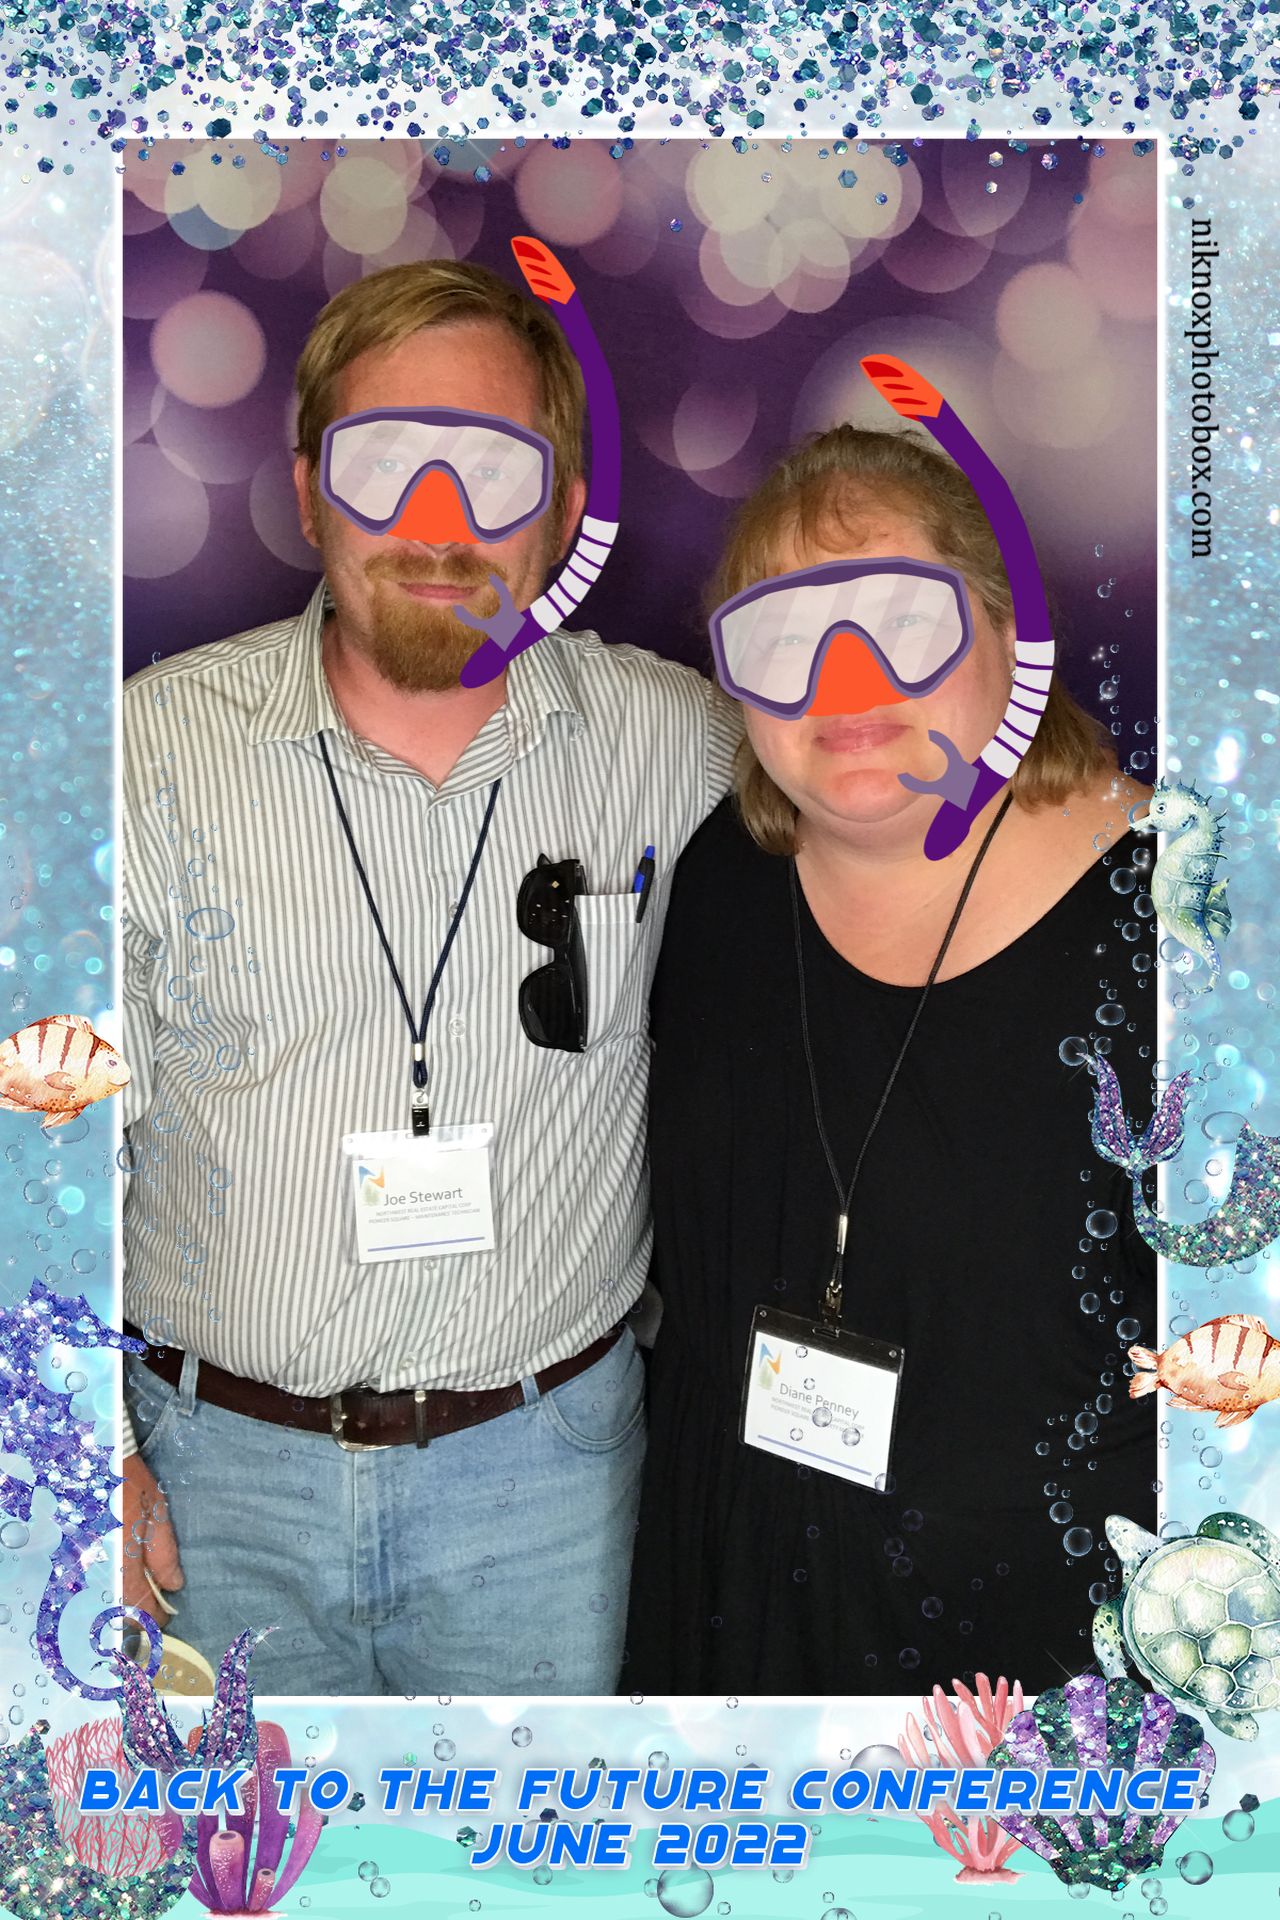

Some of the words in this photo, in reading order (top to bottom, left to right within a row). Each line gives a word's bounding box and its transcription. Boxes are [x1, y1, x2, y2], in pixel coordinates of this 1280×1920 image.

[383, 1193, 407, 1207] Joe
[409, 1187, 464, 1204] Stewart
[375, 1208, 407, 1217] NORTHWEST
[438, 1203, 458, 1211] CAPITAL
[390, 1215, 410, 1223] SQUARE
[415, 1211, 450, 1220] MAINTENANCE
[450, 1208, 481, 1216] TECHNICIAN
[779, 1382, 813, 1404] Diane
[815, 1394, 860, 1421] Penney
[770, 1403, 791, 1415] PIONEER
[791, 1410, 810, 1422] SQUARE
[771, 1396, 801, 1410] NORTHWEST
[801, 1406, 813, 1415] REAL
[831, 1416, 851, 1427] CAPITAL
